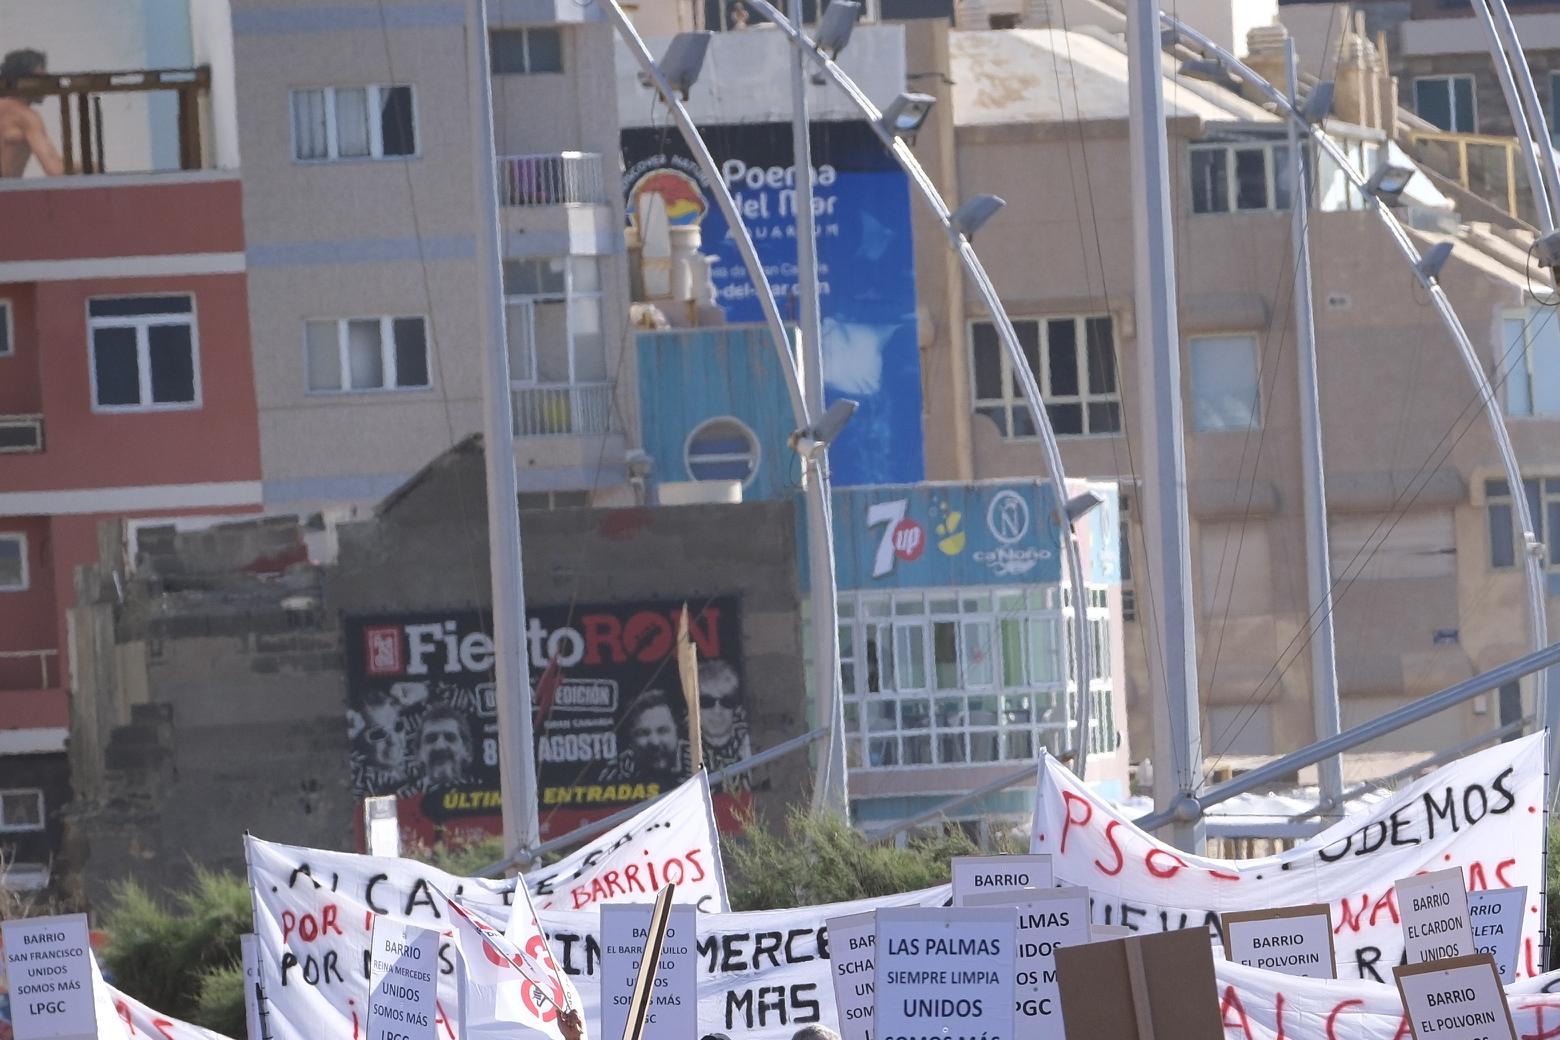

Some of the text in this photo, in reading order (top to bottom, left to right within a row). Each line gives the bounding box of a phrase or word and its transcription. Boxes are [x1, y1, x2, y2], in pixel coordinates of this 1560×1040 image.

[538, 731, 617, 763] AGOSTO
[543, 782, 660, 804] ENTRADAS
[974, 873, 1030, 887] BARRIO
[1412, 891, 1451, 912] BARRIO
[281, 903, 343, 944] POR
[1408, 915, 1464, 940] EL CARDON
[23, 932, 66, 945] BARRIO
[888, 938, 1000, 956] LAS PALMAS
[1252, 933, 1304, 949] BARRIO
[8, 947, 83, 963] SAN FRANCISCO
[385, 939, 421, 961] BARRIO
[607, 946, 617, 955] EL
[1419, 942, 1460, 963] UNIDOS
[281, 950, 344, 987] POR
[373, 958, 394, 974] REINA
[394, 965, 432, 983] MERCEDES
[1257, 952, 1320, 969] POLVORIN
[27, 965, 68, 978] UNIDOS
[887, 971, 947, 985] SIEMPRE
[951, 971, 1000, 985] LIMPIA
[17, 980, 81, 995] SOMOS MÁS
[382, 981, 420, 1002] UNIDOS
[1427, 988, 1477, 1007] BARRIO
[29, 1000, 67, 1016] LPGC
[656, 994, 681, 1006] MÁS
[725, 983, 820, 1030] MAS
[903, 998, 983, 1018] UNIDOS
[373, 1002, 405, 1023] SOMOS
[405, 1005, 429, 1027] MÁS
[1421, 1011, 1496, 1033] EL POLVORIN
